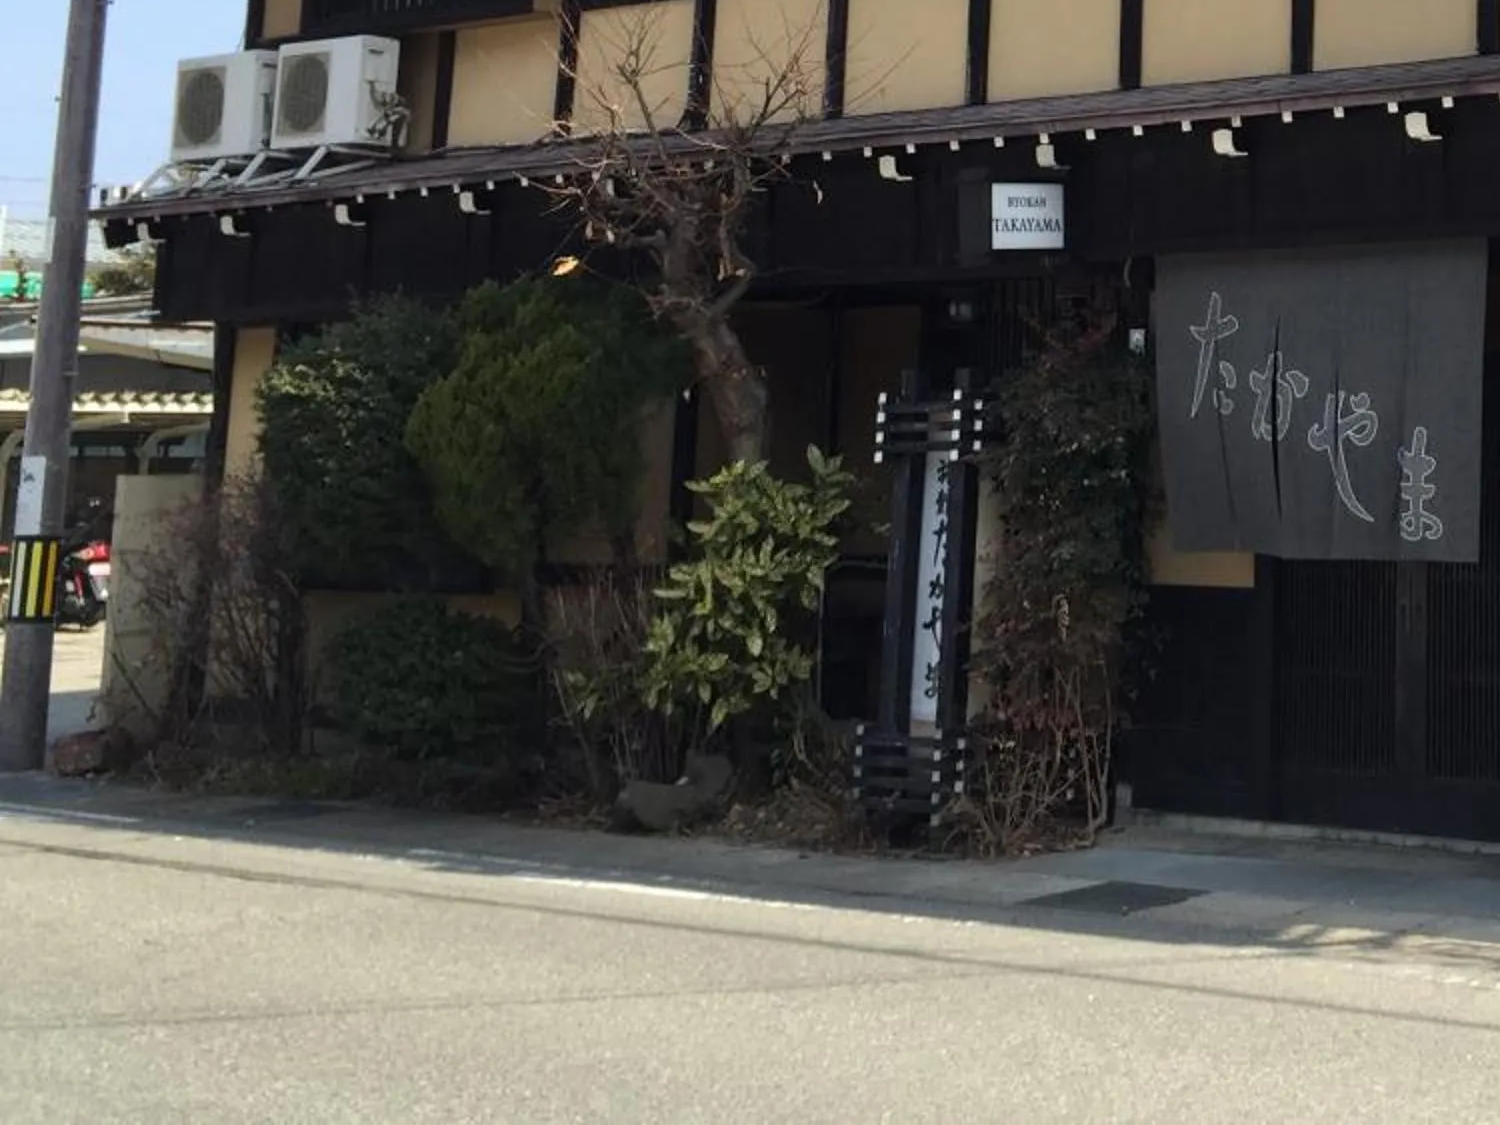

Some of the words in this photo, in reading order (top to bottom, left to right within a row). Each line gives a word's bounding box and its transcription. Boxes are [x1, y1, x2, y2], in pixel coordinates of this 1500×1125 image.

[993, 218, 1061, 232] TAKAYAMA
[1189, 291, 1443, 541] たかやま
